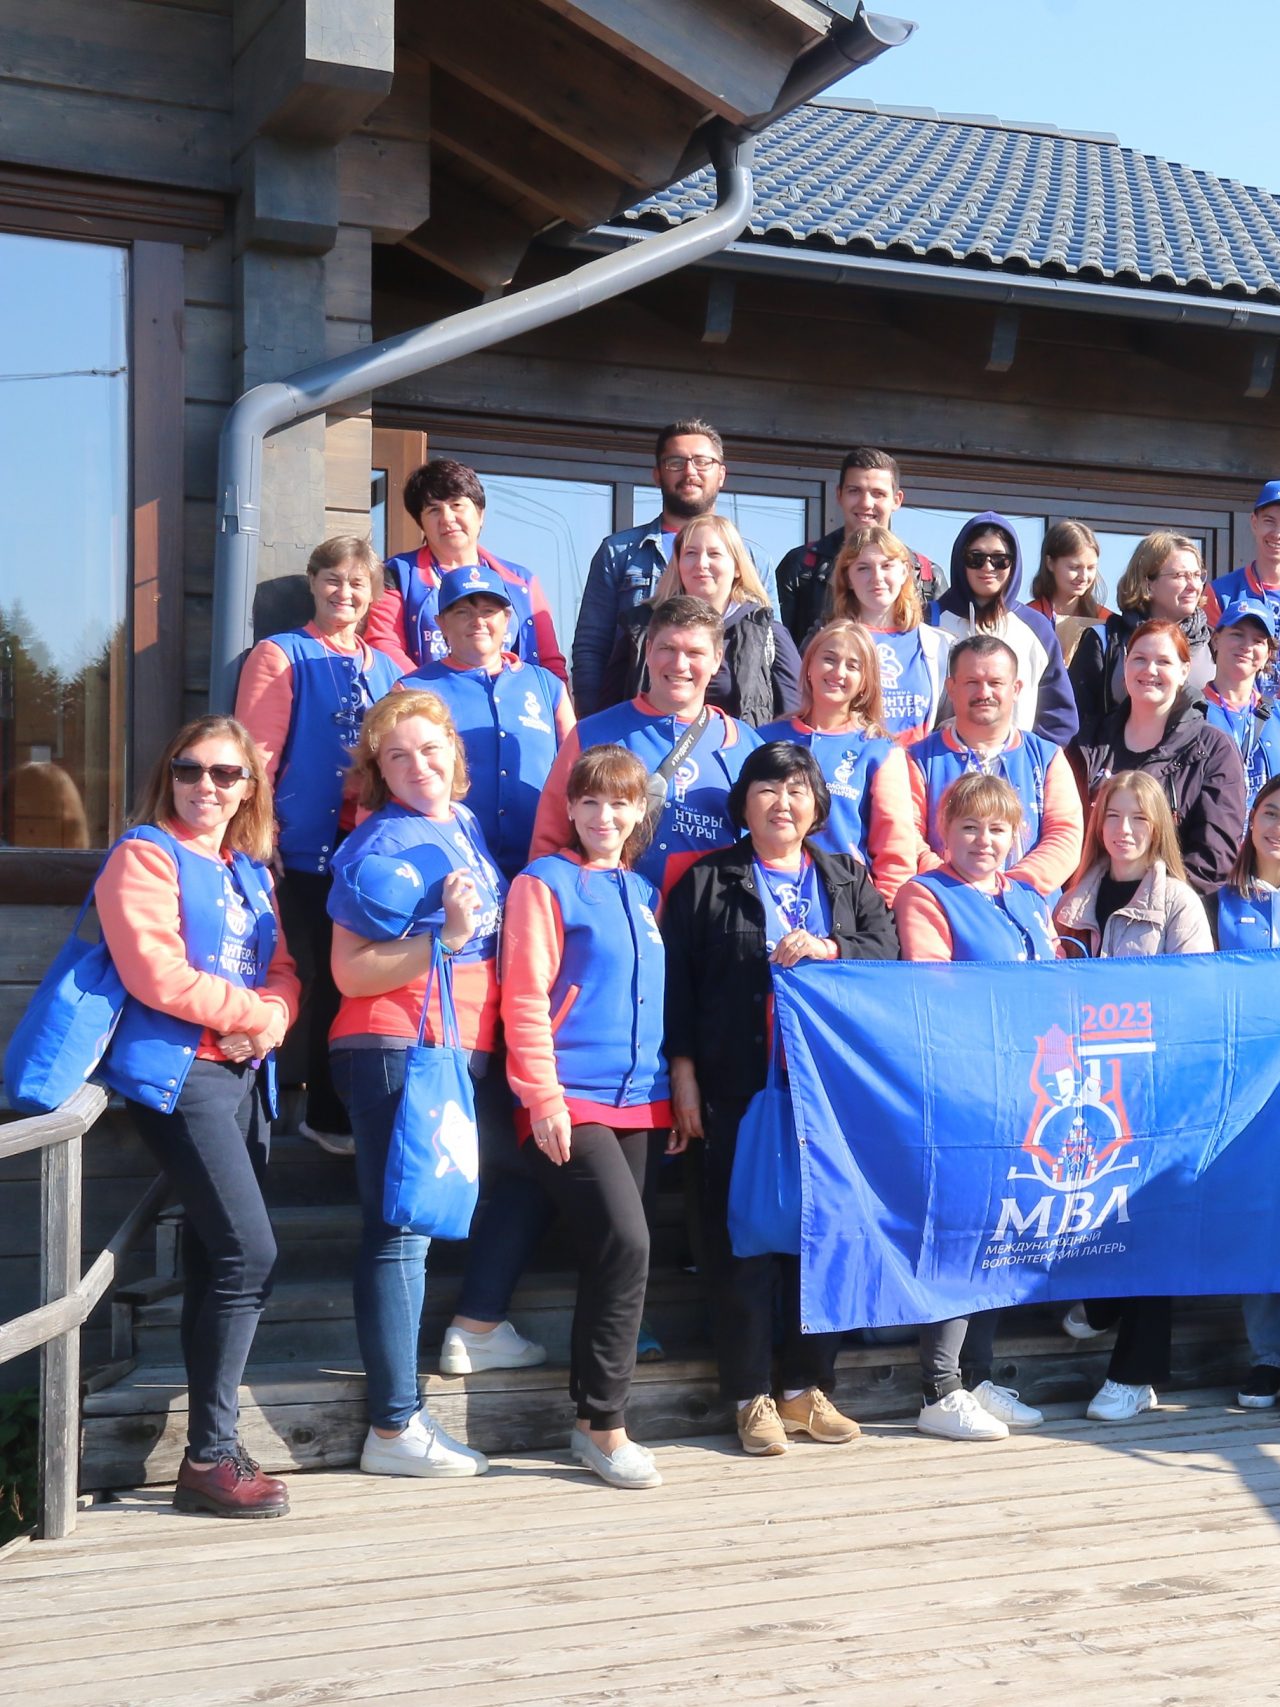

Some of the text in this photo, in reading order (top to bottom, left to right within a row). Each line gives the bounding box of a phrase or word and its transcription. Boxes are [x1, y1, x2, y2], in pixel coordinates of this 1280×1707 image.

[675, 808, 723, 829] НТЕРЫ
[1082, 1002, 1152, 1030] 2023
[990, 1184, 1131, 1242] МВЛ
[981, 1242, 1127, 1270] ВОЛОНТЕРСКИЙ ЛАГЕРЬ
[985, 1230, 1102, 1255] МЕЖДУНАРОДНЫЙ
